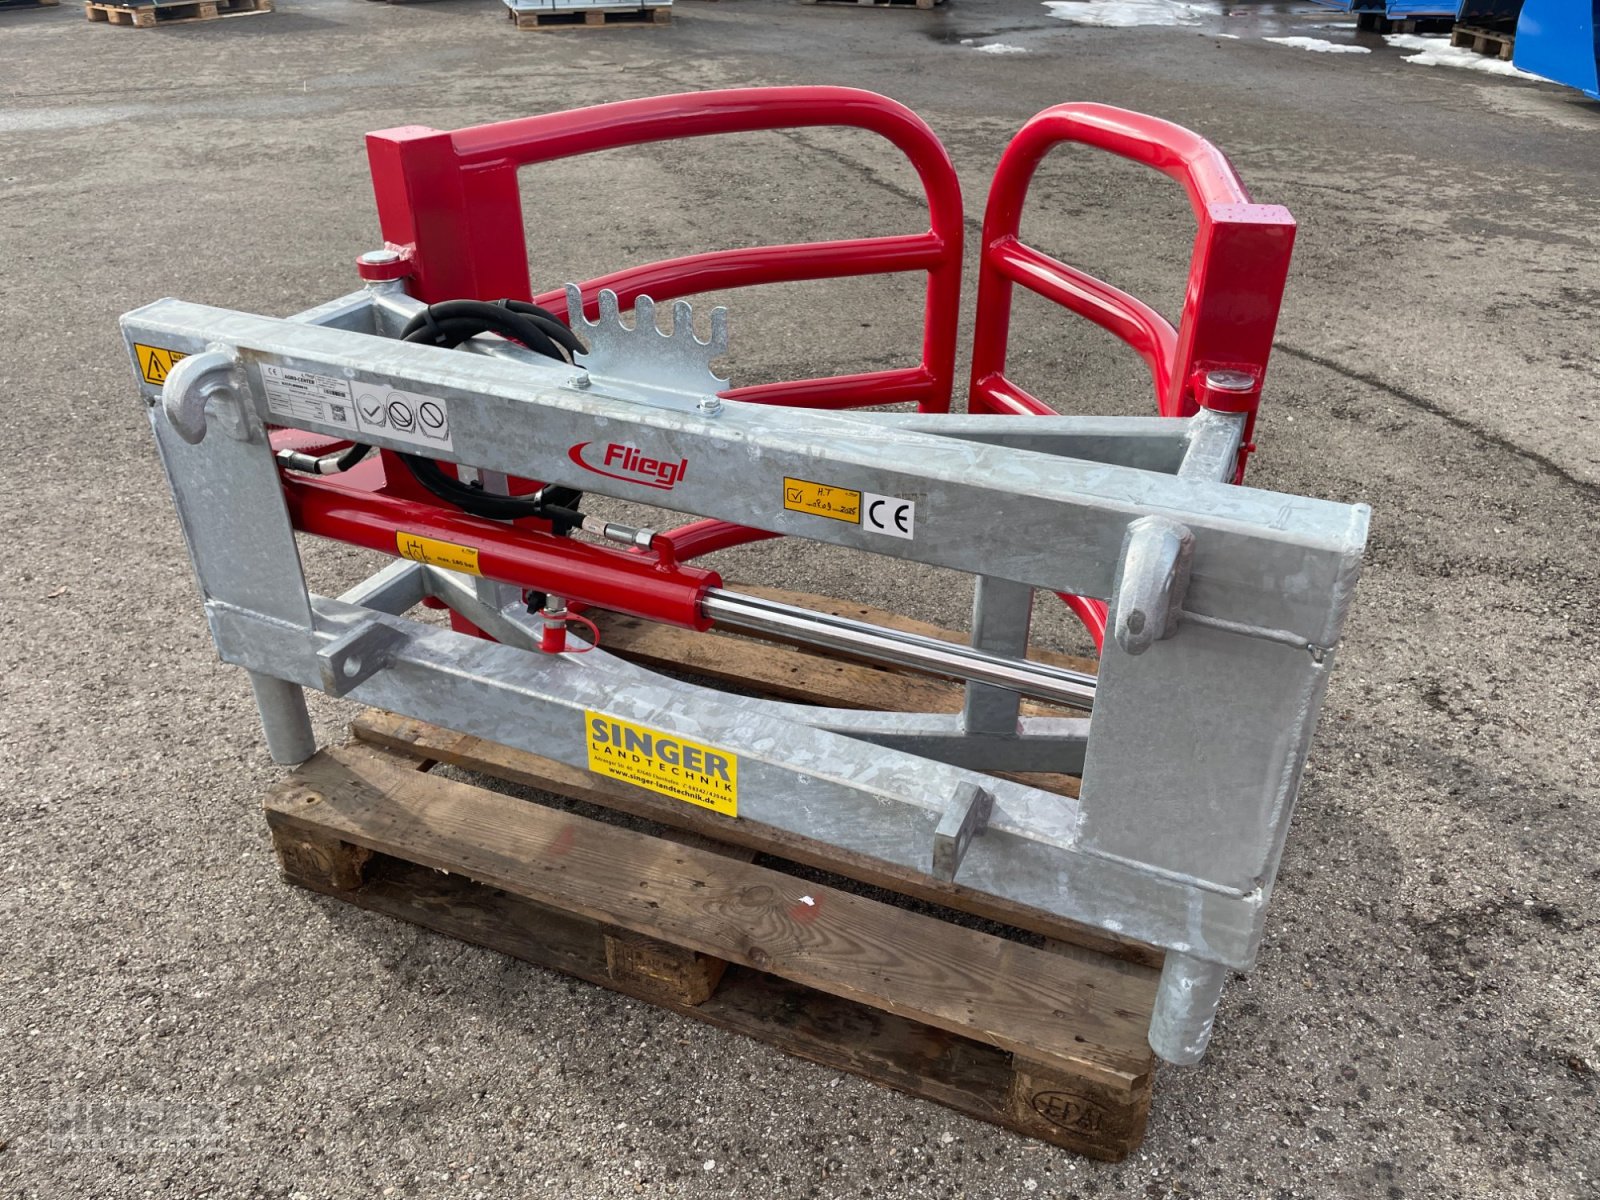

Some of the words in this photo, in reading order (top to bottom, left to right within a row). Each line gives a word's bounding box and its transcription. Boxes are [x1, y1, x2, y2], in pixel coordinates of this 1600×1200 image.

[604, 443, 689, 486] Fliegl
[869, 500, 909, 534] CE
[591, 718, 731, 782] SINGER
[592, 742, 733, 793] LANDTECHNIK
[609, 767, 715, 805] www.singer-landtechnik.de
